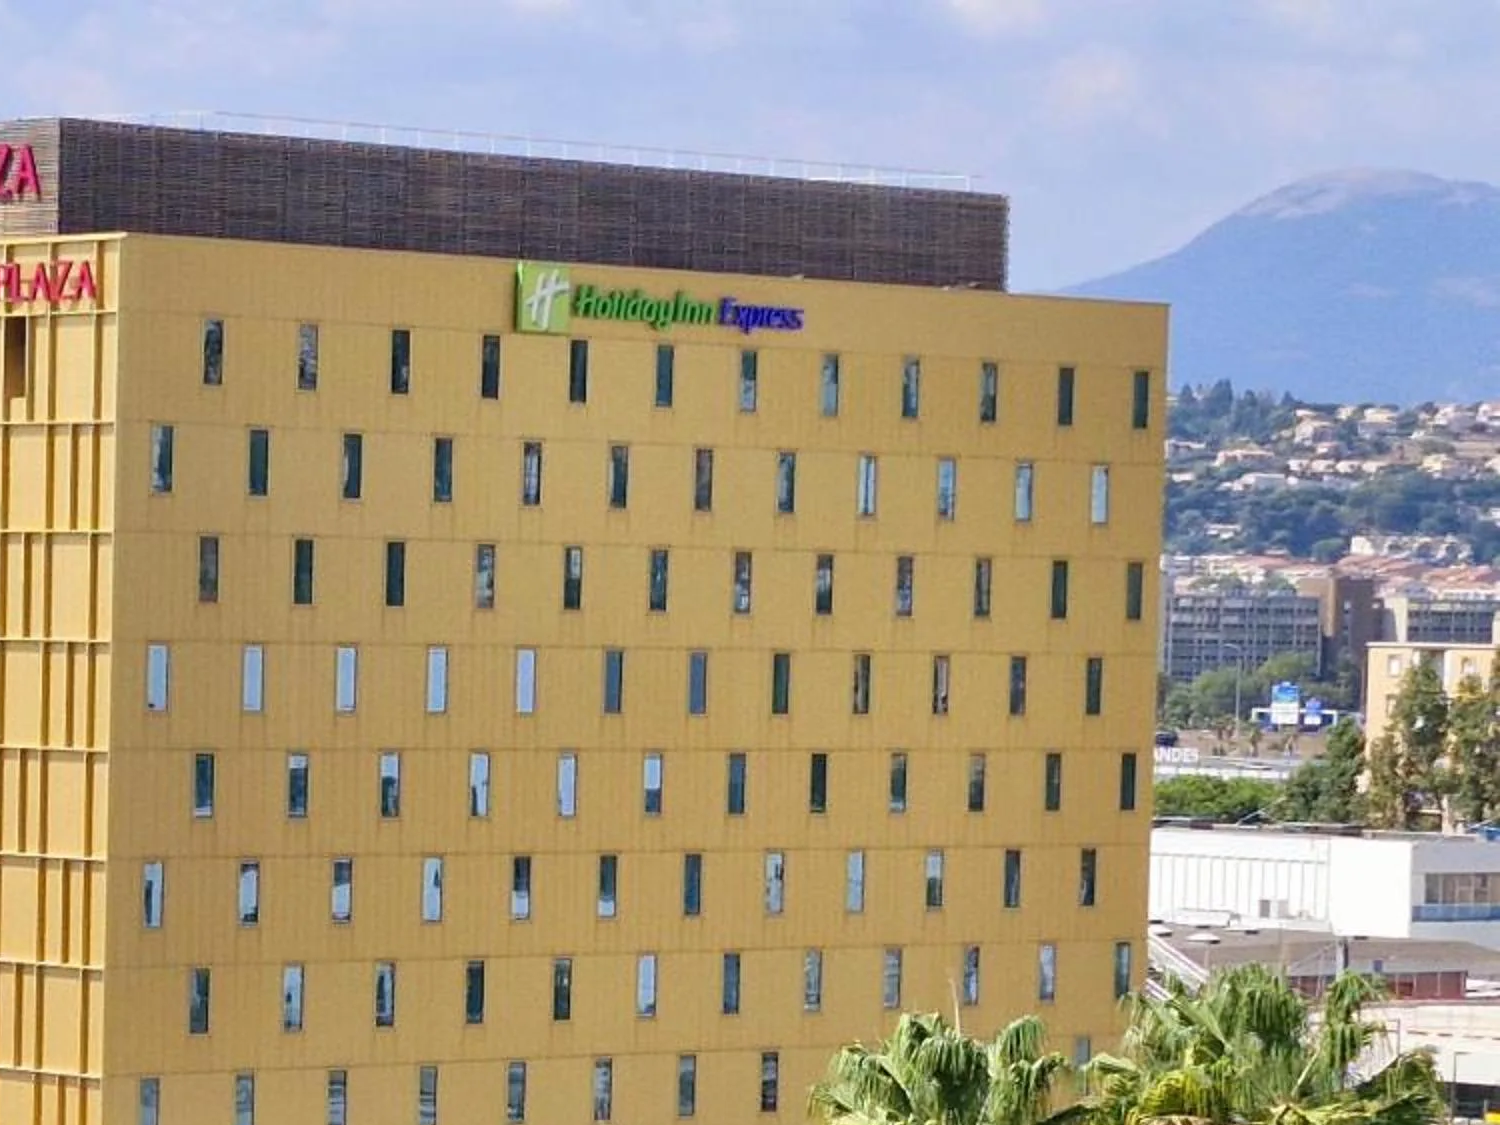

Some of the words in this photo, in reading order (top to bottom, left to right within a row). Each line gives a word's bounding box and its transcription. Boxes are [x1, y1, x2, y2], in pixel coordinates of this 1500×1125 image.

[575, 285, 674, 331] Holiday
[674, 289, 715, 325] Inn
[718, 296, 804, 333] Express
